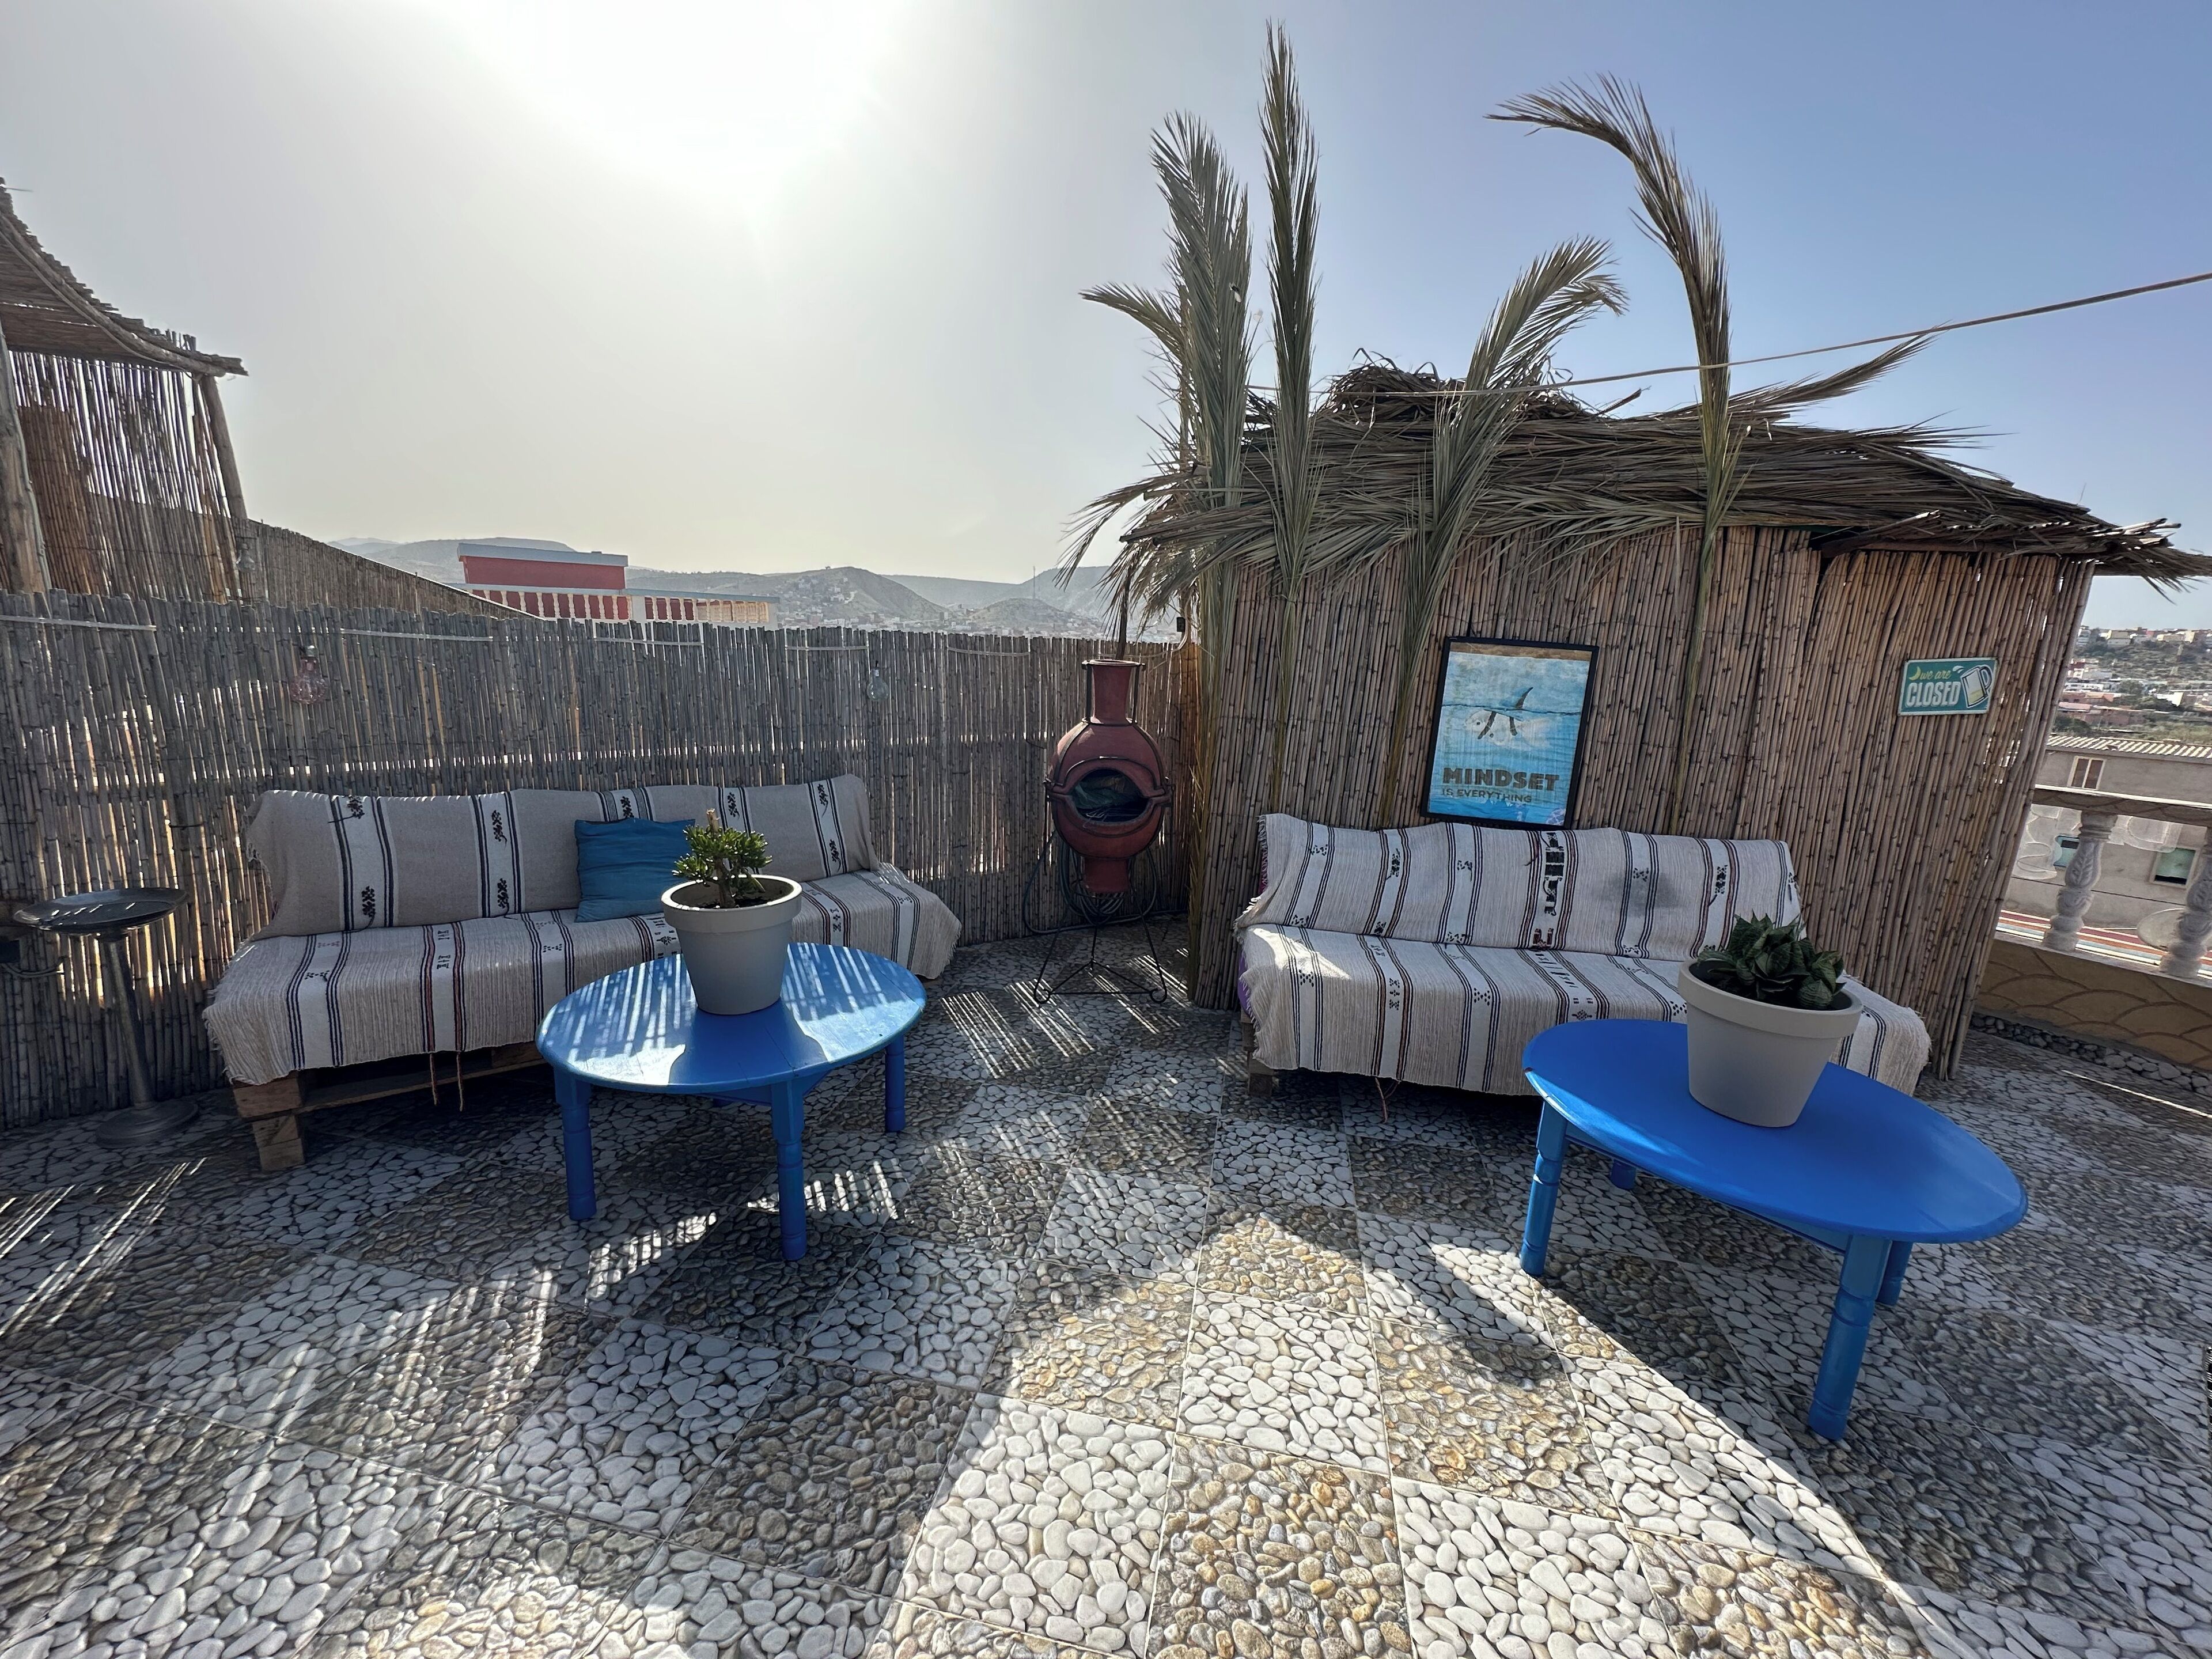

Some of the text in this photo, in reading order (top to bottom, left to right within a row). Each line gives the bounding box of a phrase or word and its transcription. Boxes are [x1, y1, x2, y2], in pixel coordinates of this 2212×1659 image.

[1920, 670, 1952, 680] we are
[1906, 681, 1961, 707] CLOSED
[1442, 767, 1560, 791] MINDSET
[1457, 789, 1532, 802] EVERYTHING
